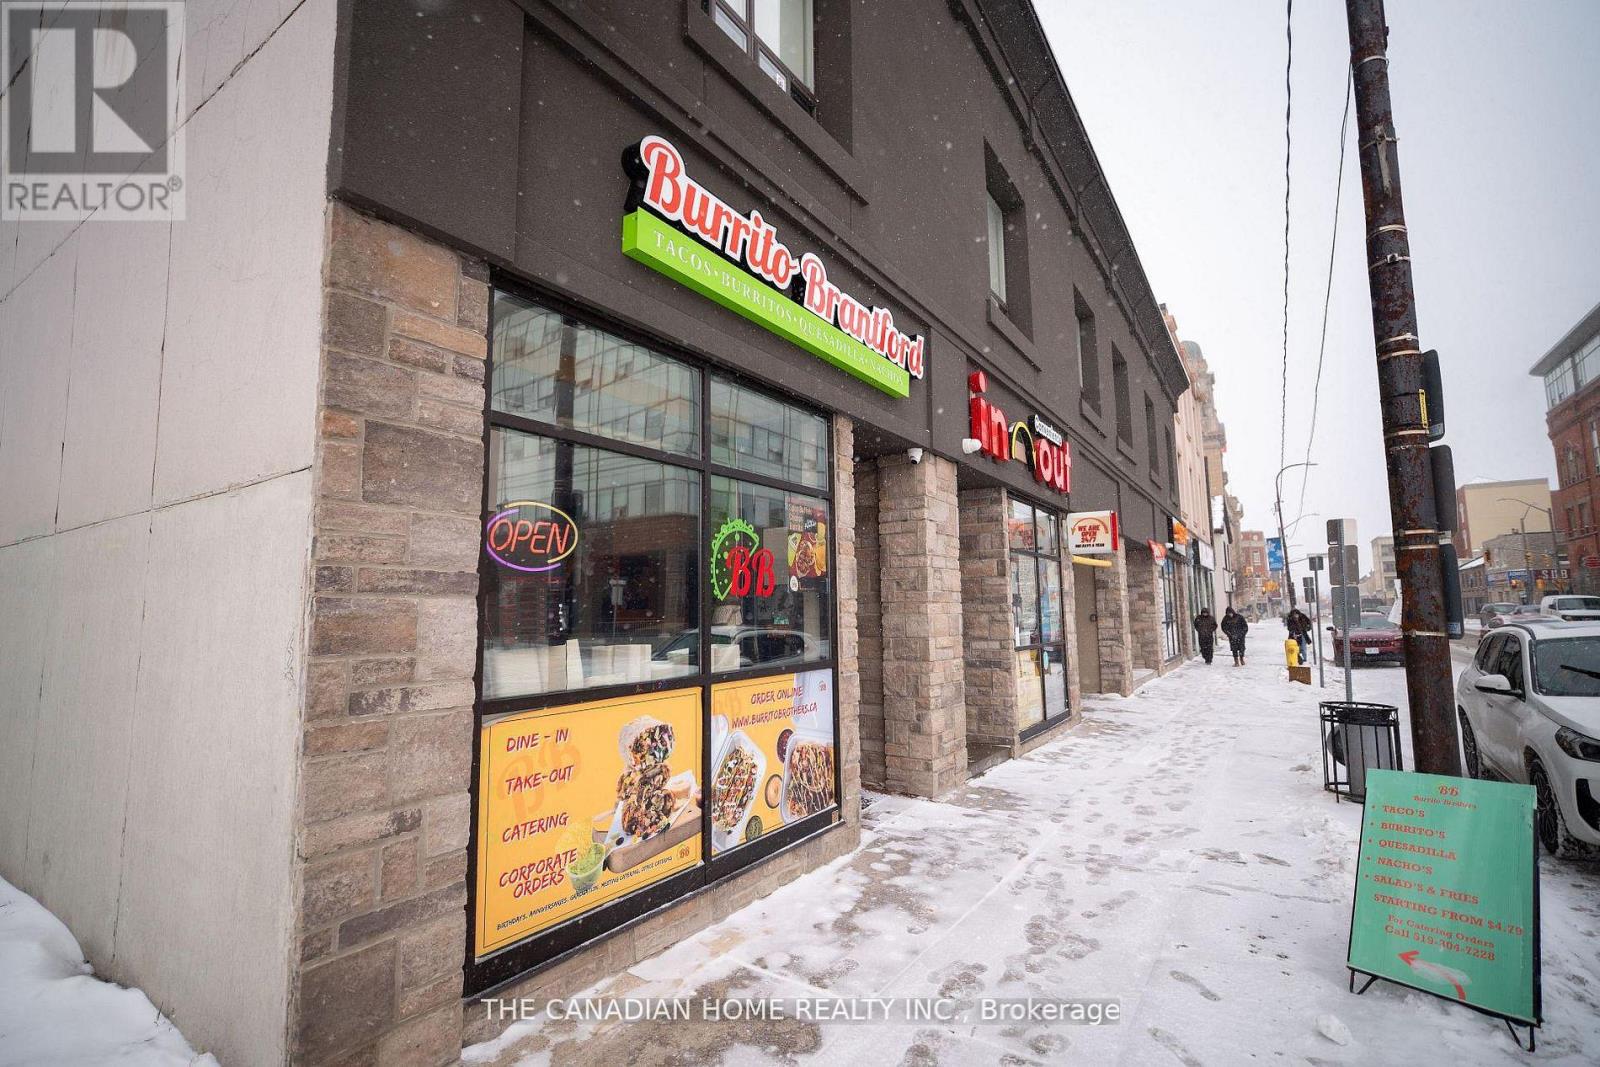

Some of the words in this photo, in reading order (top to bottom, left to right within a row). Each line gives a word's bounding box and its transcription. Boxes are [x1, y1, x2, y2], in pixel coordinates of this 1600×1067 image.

[641, 136, 800, 289] Burrito
[801, 254, 924, 378] Brantford
[653, 230, 712, 277] TACOS
[721, 271, 793, 321] BURRITOS
[489, 518, 571, 554] OPEN
[726, 545, 776, 598] BB
[750, 690, 776, 705] ORDER
[776, 686, 804, 700] ONLINE
[732, 702, 818, 729] WWW.BURRITOBROTHERS.CA
[506, 732, 540, 752] DINE
[555, 728, 569, 744] IN
[505, 764, 575, 795] TAKE-OUT
[1382, 804, 1425, 818] TACO'S
[502, 812, 570, 843] CATERING
[1381, 822, 1446, 840] BURRITO'S
[1376, 856, 1433, 875] NACHO'S
[1378, 839, 1457, 861] QUESADILLA
[499, 847, 578, 888] CORPORATE
[513, 868, 565, 899] ORDERS
[1373, 874, 1424, 892] SALAD'S
[1426, 886, 1436, 896] &
[1440, 888, 1480, 905] FRIES
[1374, 893, 1438, 916] STARTING
[1441, 909, 1484, 928] FROM
[1384, 924, 1410, 939] Call
[1388, 913, 1403, 925] For
[1406, 918, 1453, 939] Catering
[1455, 932, 1496, 949] Orders
